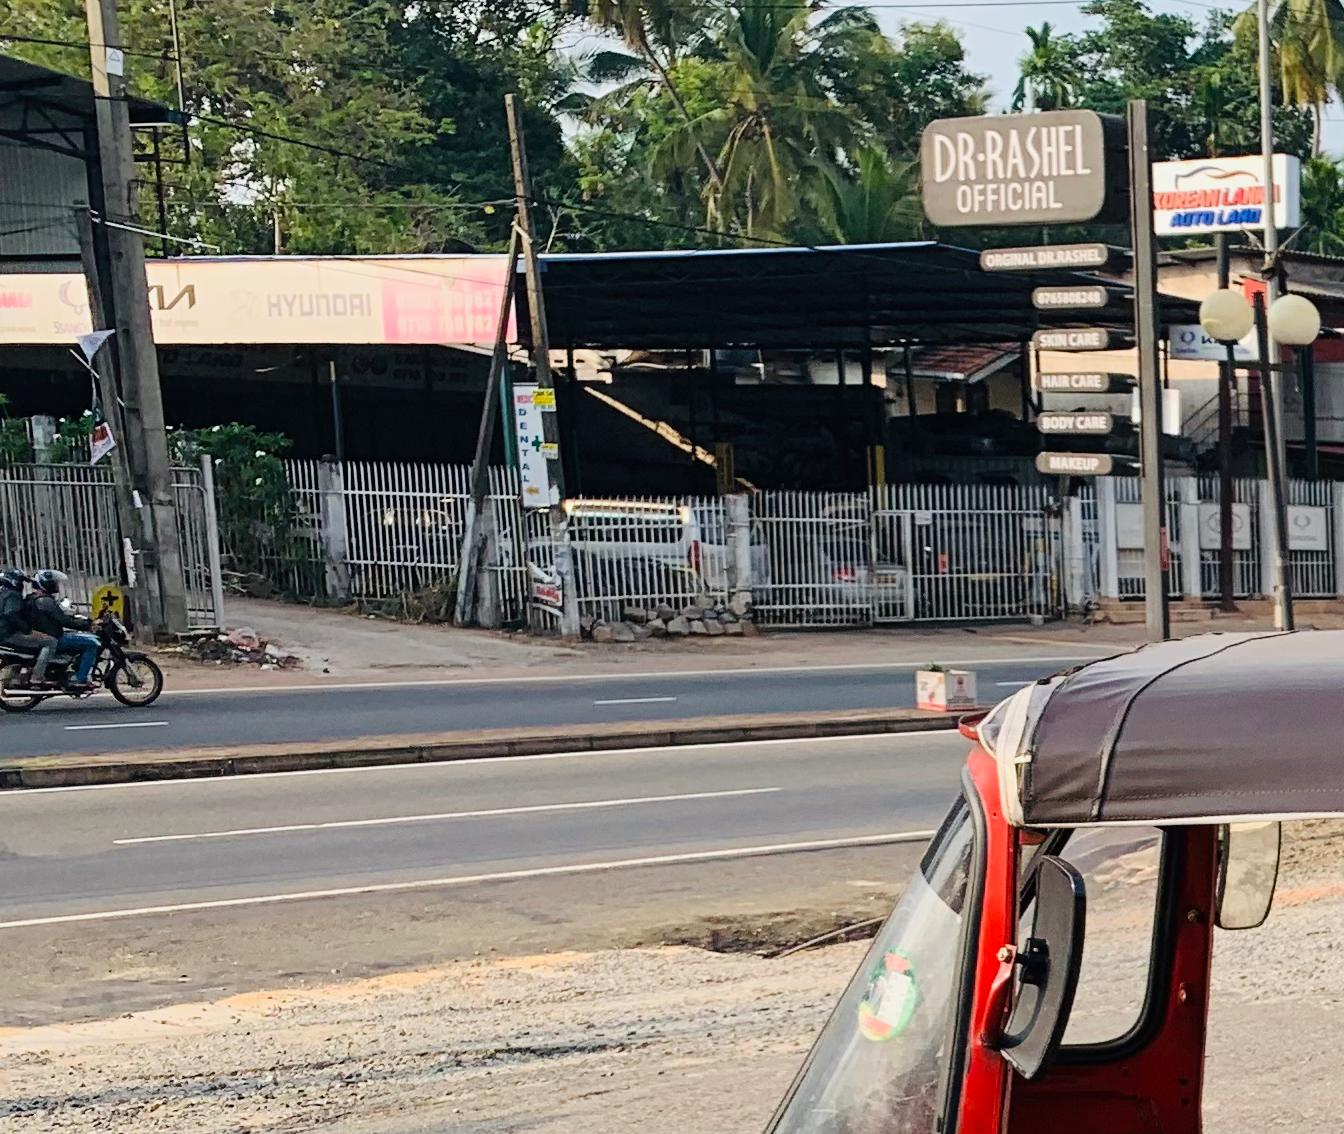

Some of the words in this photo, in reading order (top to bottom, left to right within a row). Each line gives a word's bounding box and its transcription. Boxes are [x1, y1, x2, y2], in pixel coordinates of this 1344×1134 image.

[956, 181, 1063, 214] OFFICIAL
[1170, 211, 1215, 227] AUTO
[267, 293, 372, 318] HYUNDAI
[1040, 333, 1067, 347] SKIN
[1068, 333, 1100, 346] CARE
[1041, 374, 1070, 388] HAIR
[1070, 374, 1102, 388] CARE
[1042, 416, 1075, 430] BODY
[1075, 415, 1107, 429] CARE
[1049, 457, 1100, 471] MAKEUP
